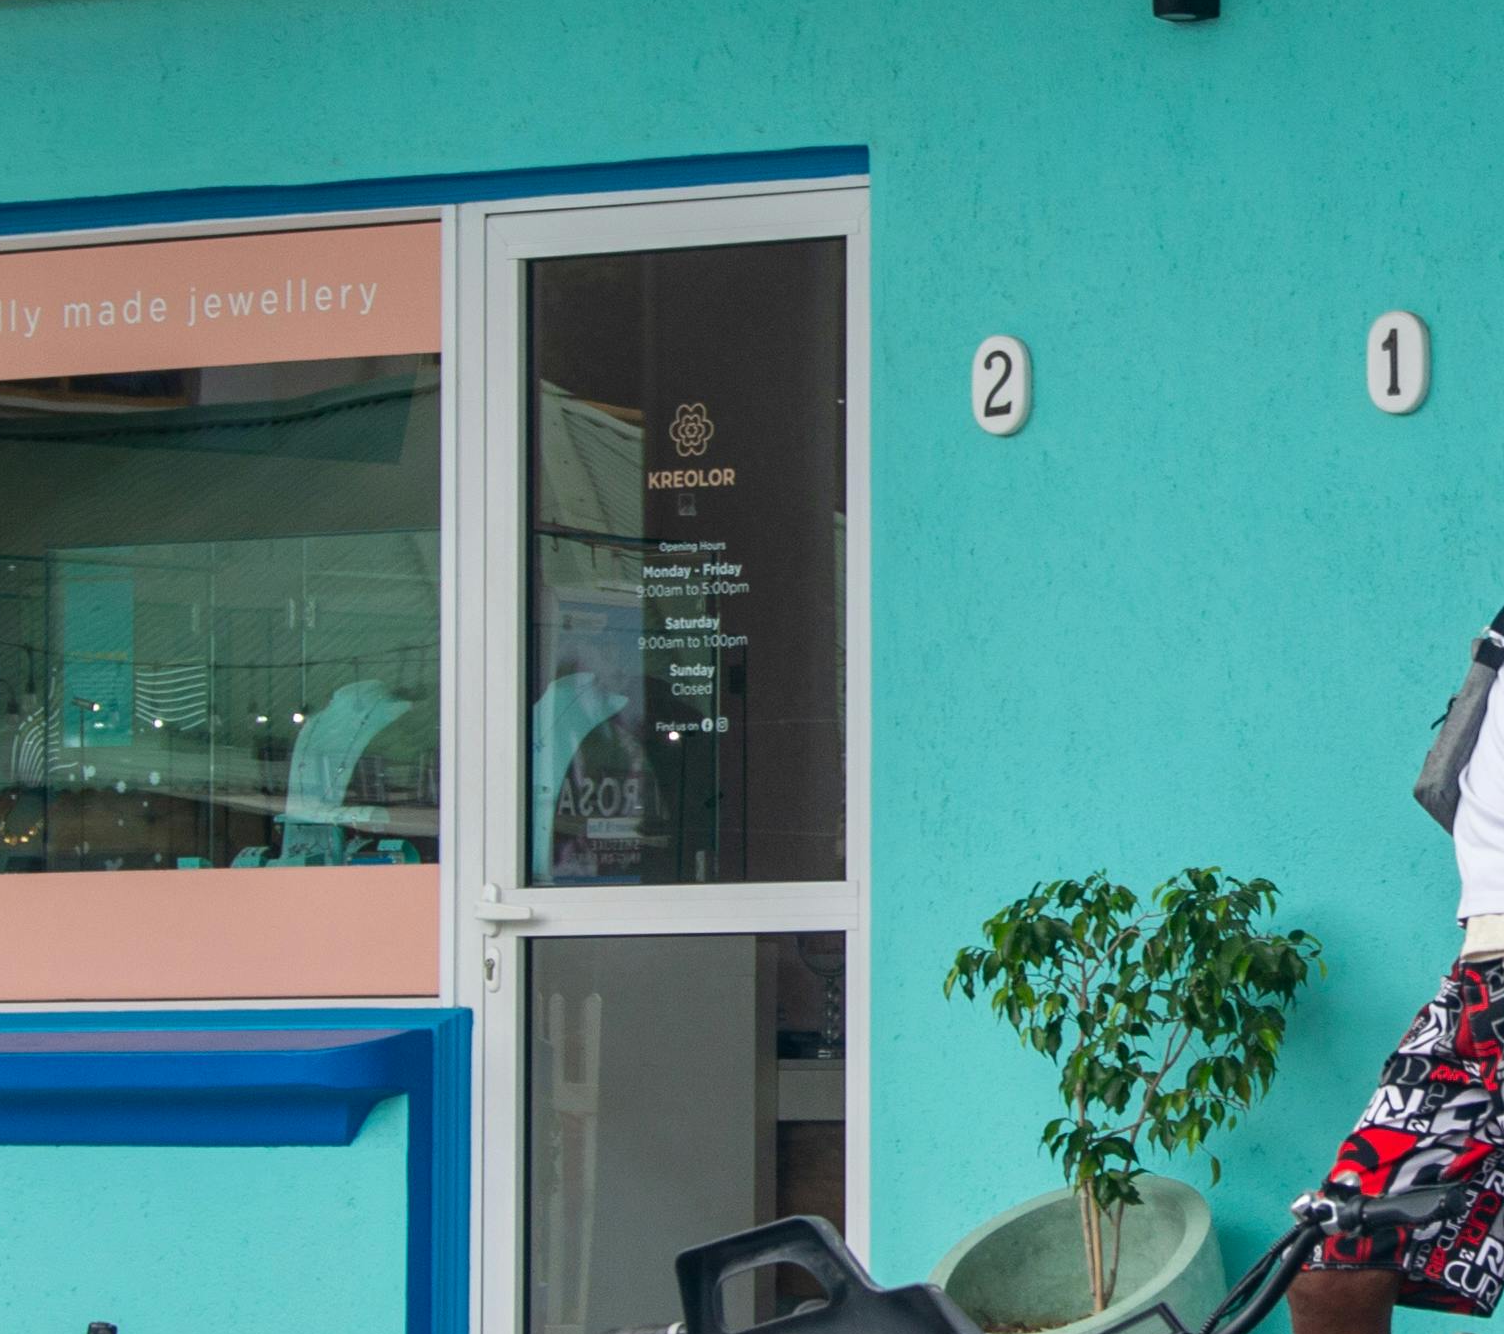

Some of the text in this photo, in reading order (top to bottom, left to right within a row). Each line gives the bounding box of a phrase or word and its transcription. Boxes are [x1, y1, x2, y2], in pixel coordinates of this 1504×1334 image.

[64, 288, 169, 328] made
[186, 277, 380, 327] jewellery
[1381, 328, 1403, 397] 1
[983, 349, 1014, 419] 2
[648, 468, 736, 489] KREOLOR
[659, 541, 726, 553] Opening Hours
[643, 565, 691, 579] Monday
[703, 563, 742, 576] Friday
[636, 581, 750, 598] 9:00am to 5:00pm
[665, 616, 720, 631] Saturday
[637, 634, 749, 650] 9:00am to 1:00pm
[669, 663, 715, 679] Sunday
[671, 682, 713, 696] Closed
